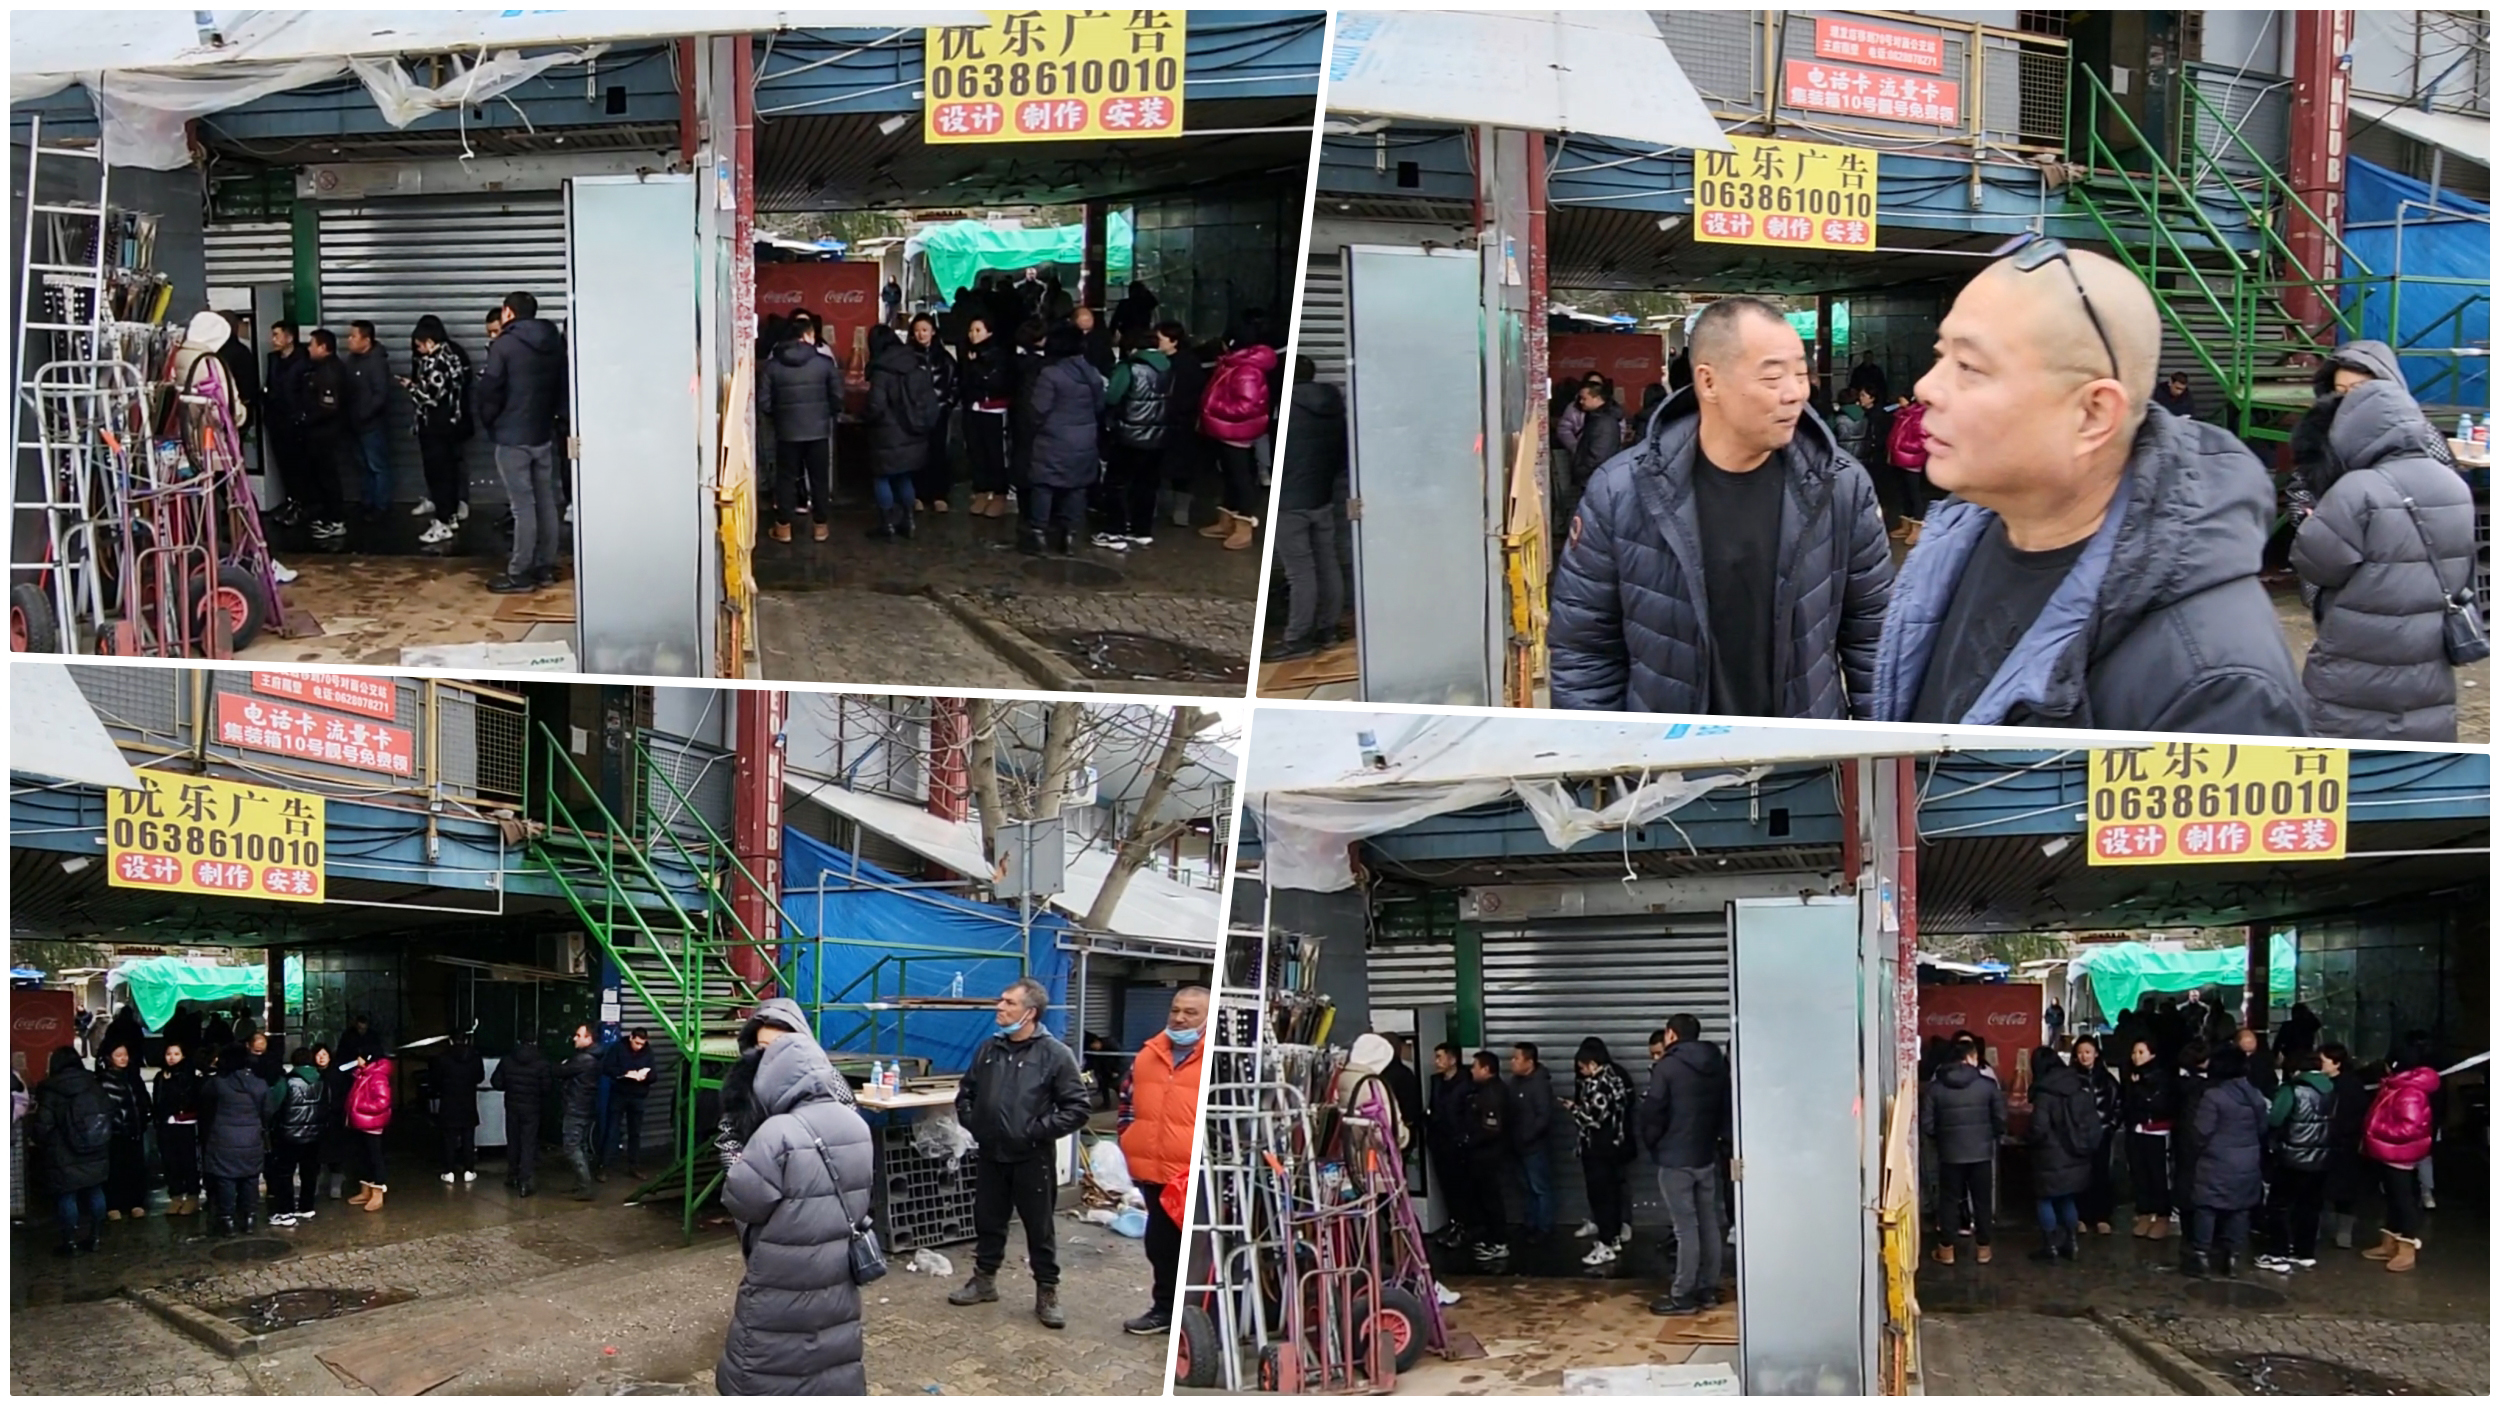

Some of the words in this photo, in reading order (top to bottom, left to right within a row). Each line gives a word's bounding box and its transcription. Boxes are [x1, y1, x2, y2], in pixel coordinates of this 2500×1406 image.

[932, 57, 1176, 99] 0638610010
[1808, 67, 1872, 94] 电话卡
[1879, 77, 1940, 103] 流量卡
[938, 105, 1000, 133] 设计
[1022, 102, 1083, 131] 制作
[1105, 97, 1168, 129] 安装
[2327, 78, 2343, 183] KLUB
[1700, 180, 1872, 218] 0638610010
[1706, 213, 1752, 236] 设计
[1767, 217, 1811, 241] 制作
[1825, 220, 1866, 243] 安装
[244, 702, 317, 736] 电话卡
[326, 719, 393, 750] 流量卡
[118, 776, 316, 837] 优乐广告
[766, 754, 780, 850] KLUB
[2095, 779, 2340, 821] 0638610010
[114, 818, 319, 867] 0638610010
[2102, 824, 2163, 855] 设计
[2185, 821, 2246, 852] 制作
[2268, 819, 2331, 850] 安装
[122, 855, 178, 882] 设计
[198, 863, 249, 889] 制作
[267, 868, 313, 894] 安装
